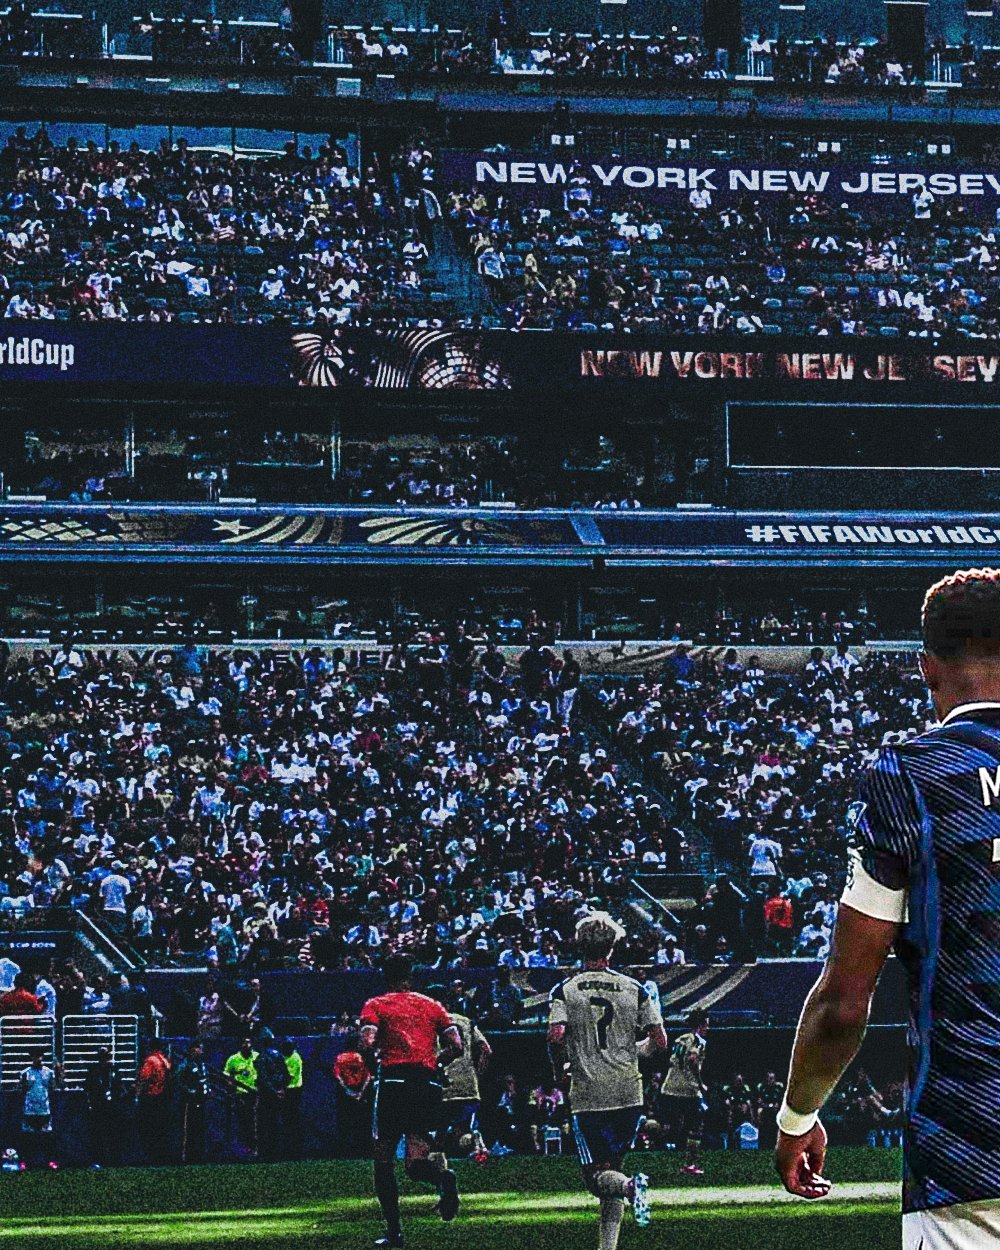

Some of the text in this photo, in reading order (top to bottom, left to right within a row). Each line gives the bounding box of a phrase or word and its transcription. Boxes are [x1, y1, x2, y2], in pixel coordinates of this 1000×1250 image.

[475, 161, 567, 184] NEW
[591, 164, 717, 190] YORK
[729, 169, 830, 192] NEW
[590, 995, 615, 1050] 7
